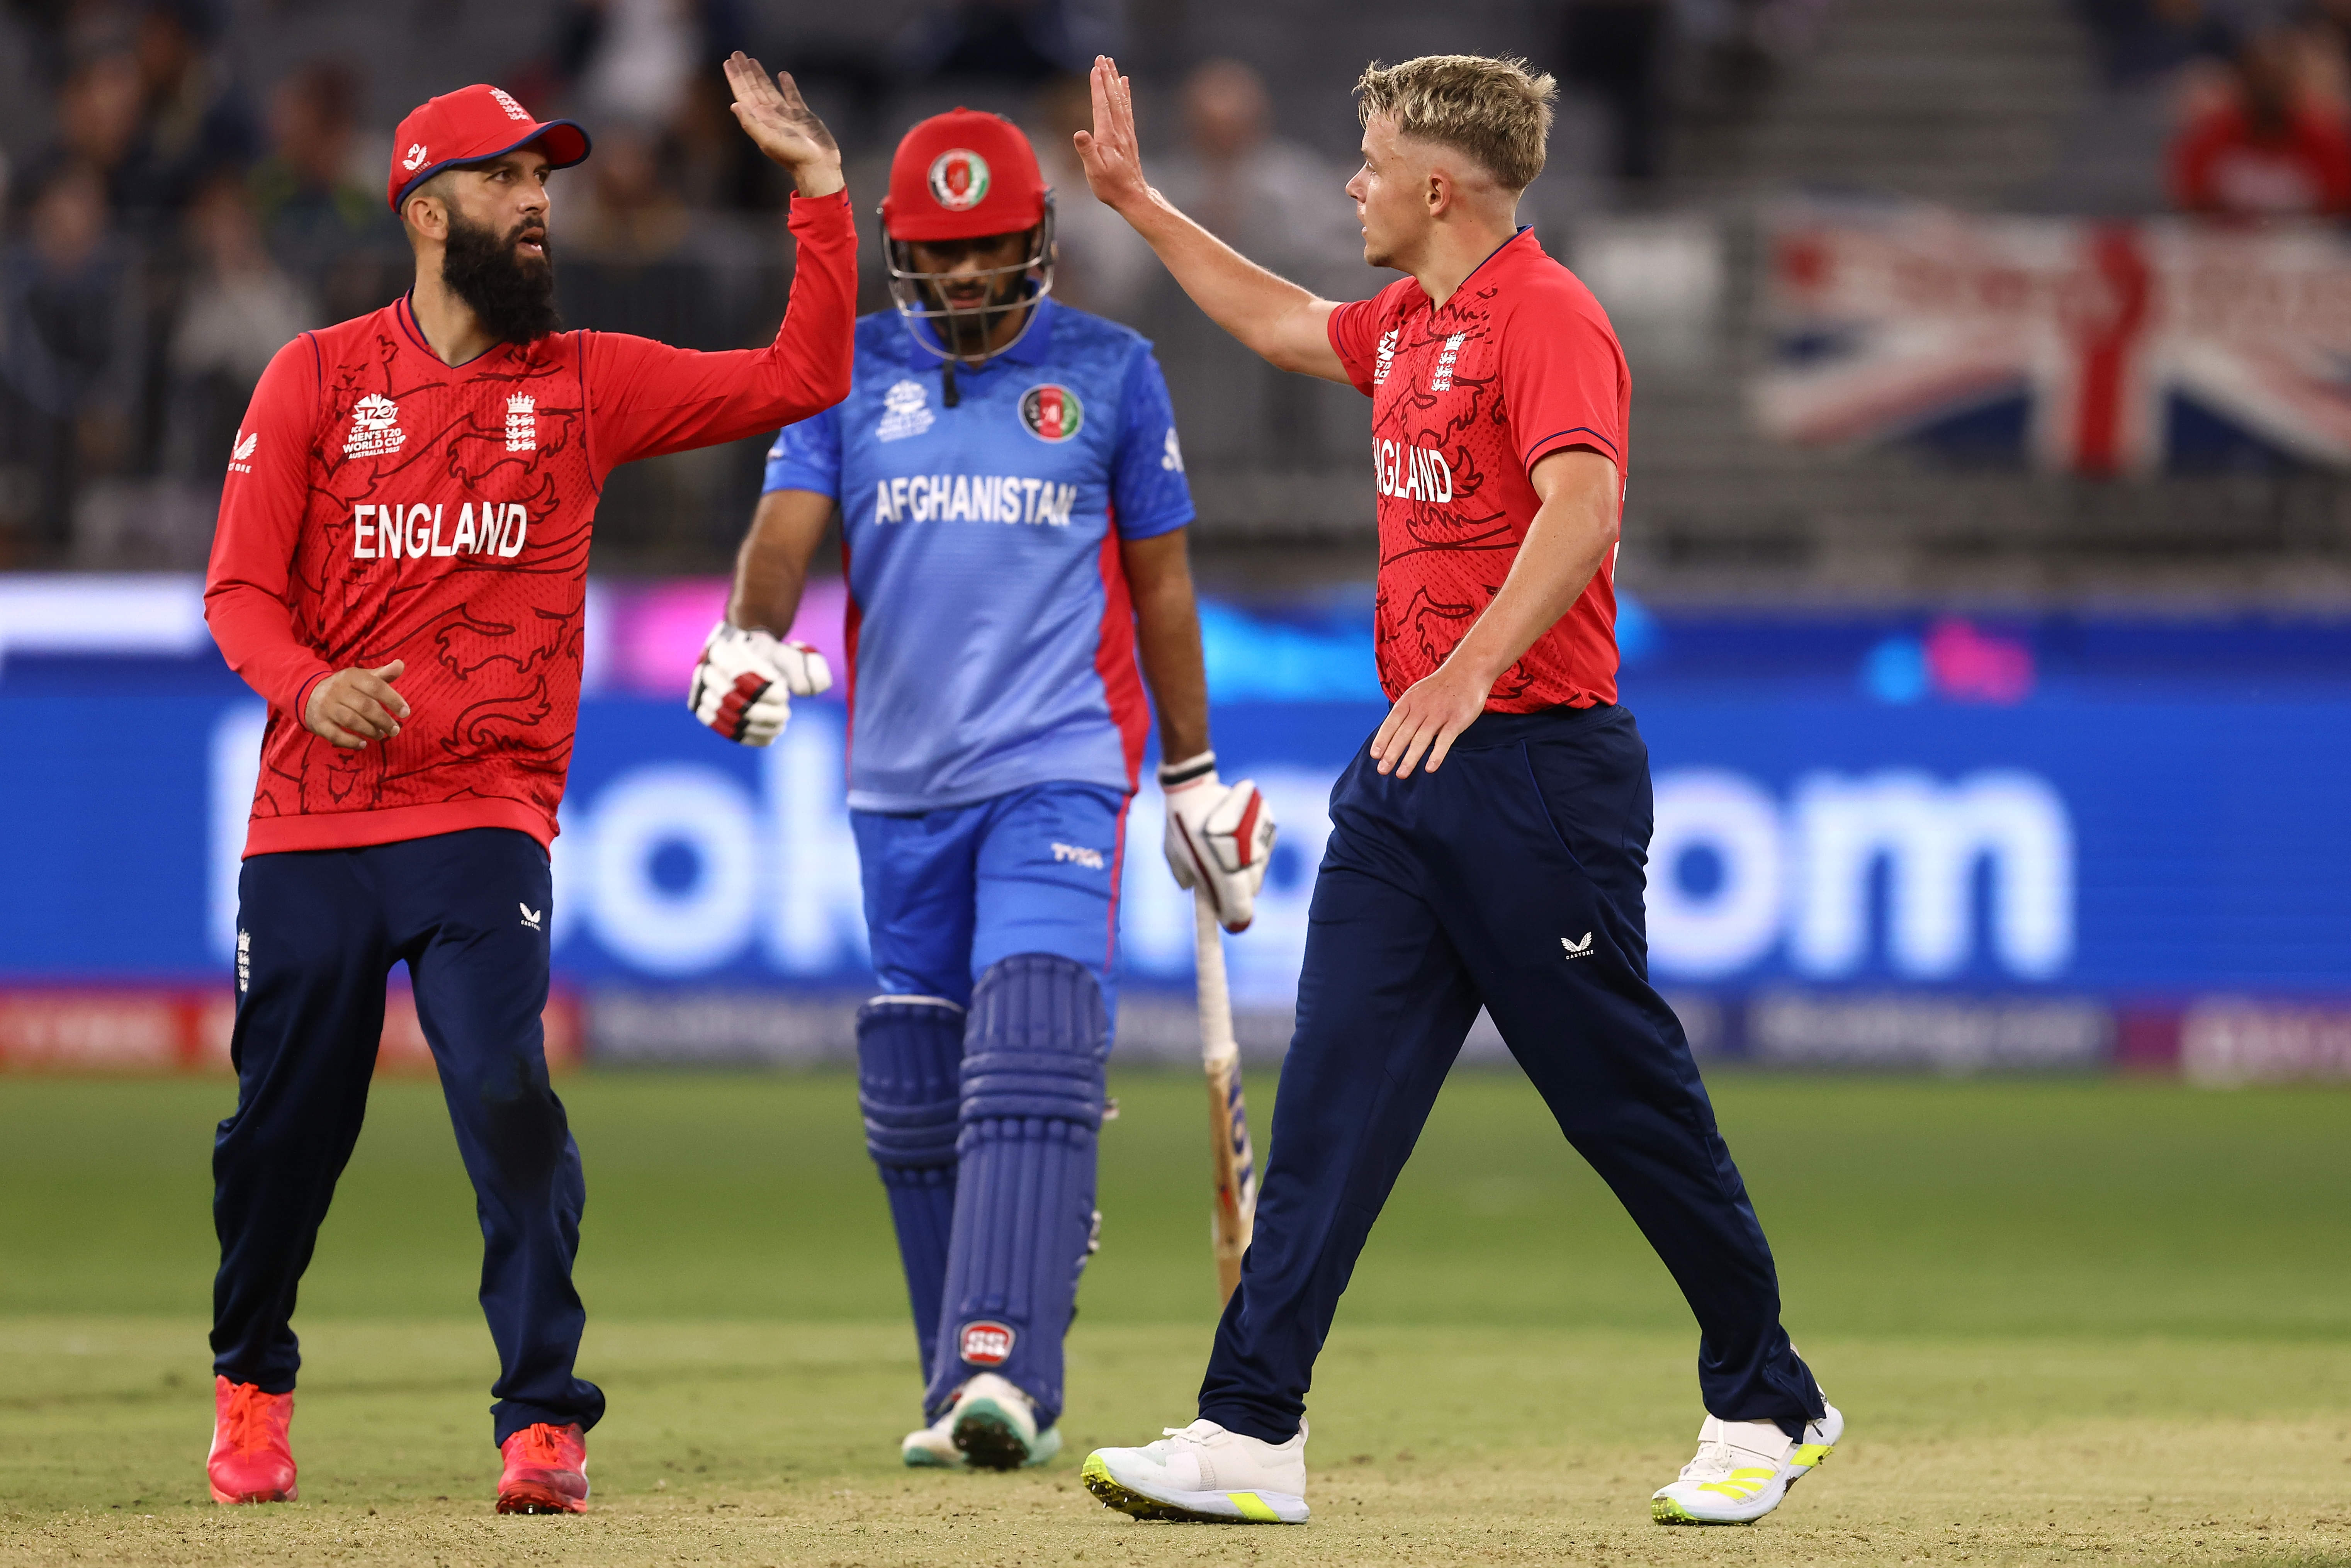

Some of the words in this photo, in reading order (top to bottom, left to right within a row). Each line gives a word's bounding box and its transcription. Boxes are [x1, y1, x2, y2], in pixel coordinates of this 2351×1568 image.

[343, 439, 383, 453] WORLD
[384, 435, 406, 447] CUP
[348, 430, 382, 443] MEN'S
[382, 428, 402, 438] T20
[348, 448, 384, 460] AUSTRALIA
[1372, 437, 1452, 503] NGLAND
[875, 474, 1077, 526] AFGHANISTAN
[353, 501, 527, 559] ENGLAND
[1566, 950, 1594, 960] CASTORE
